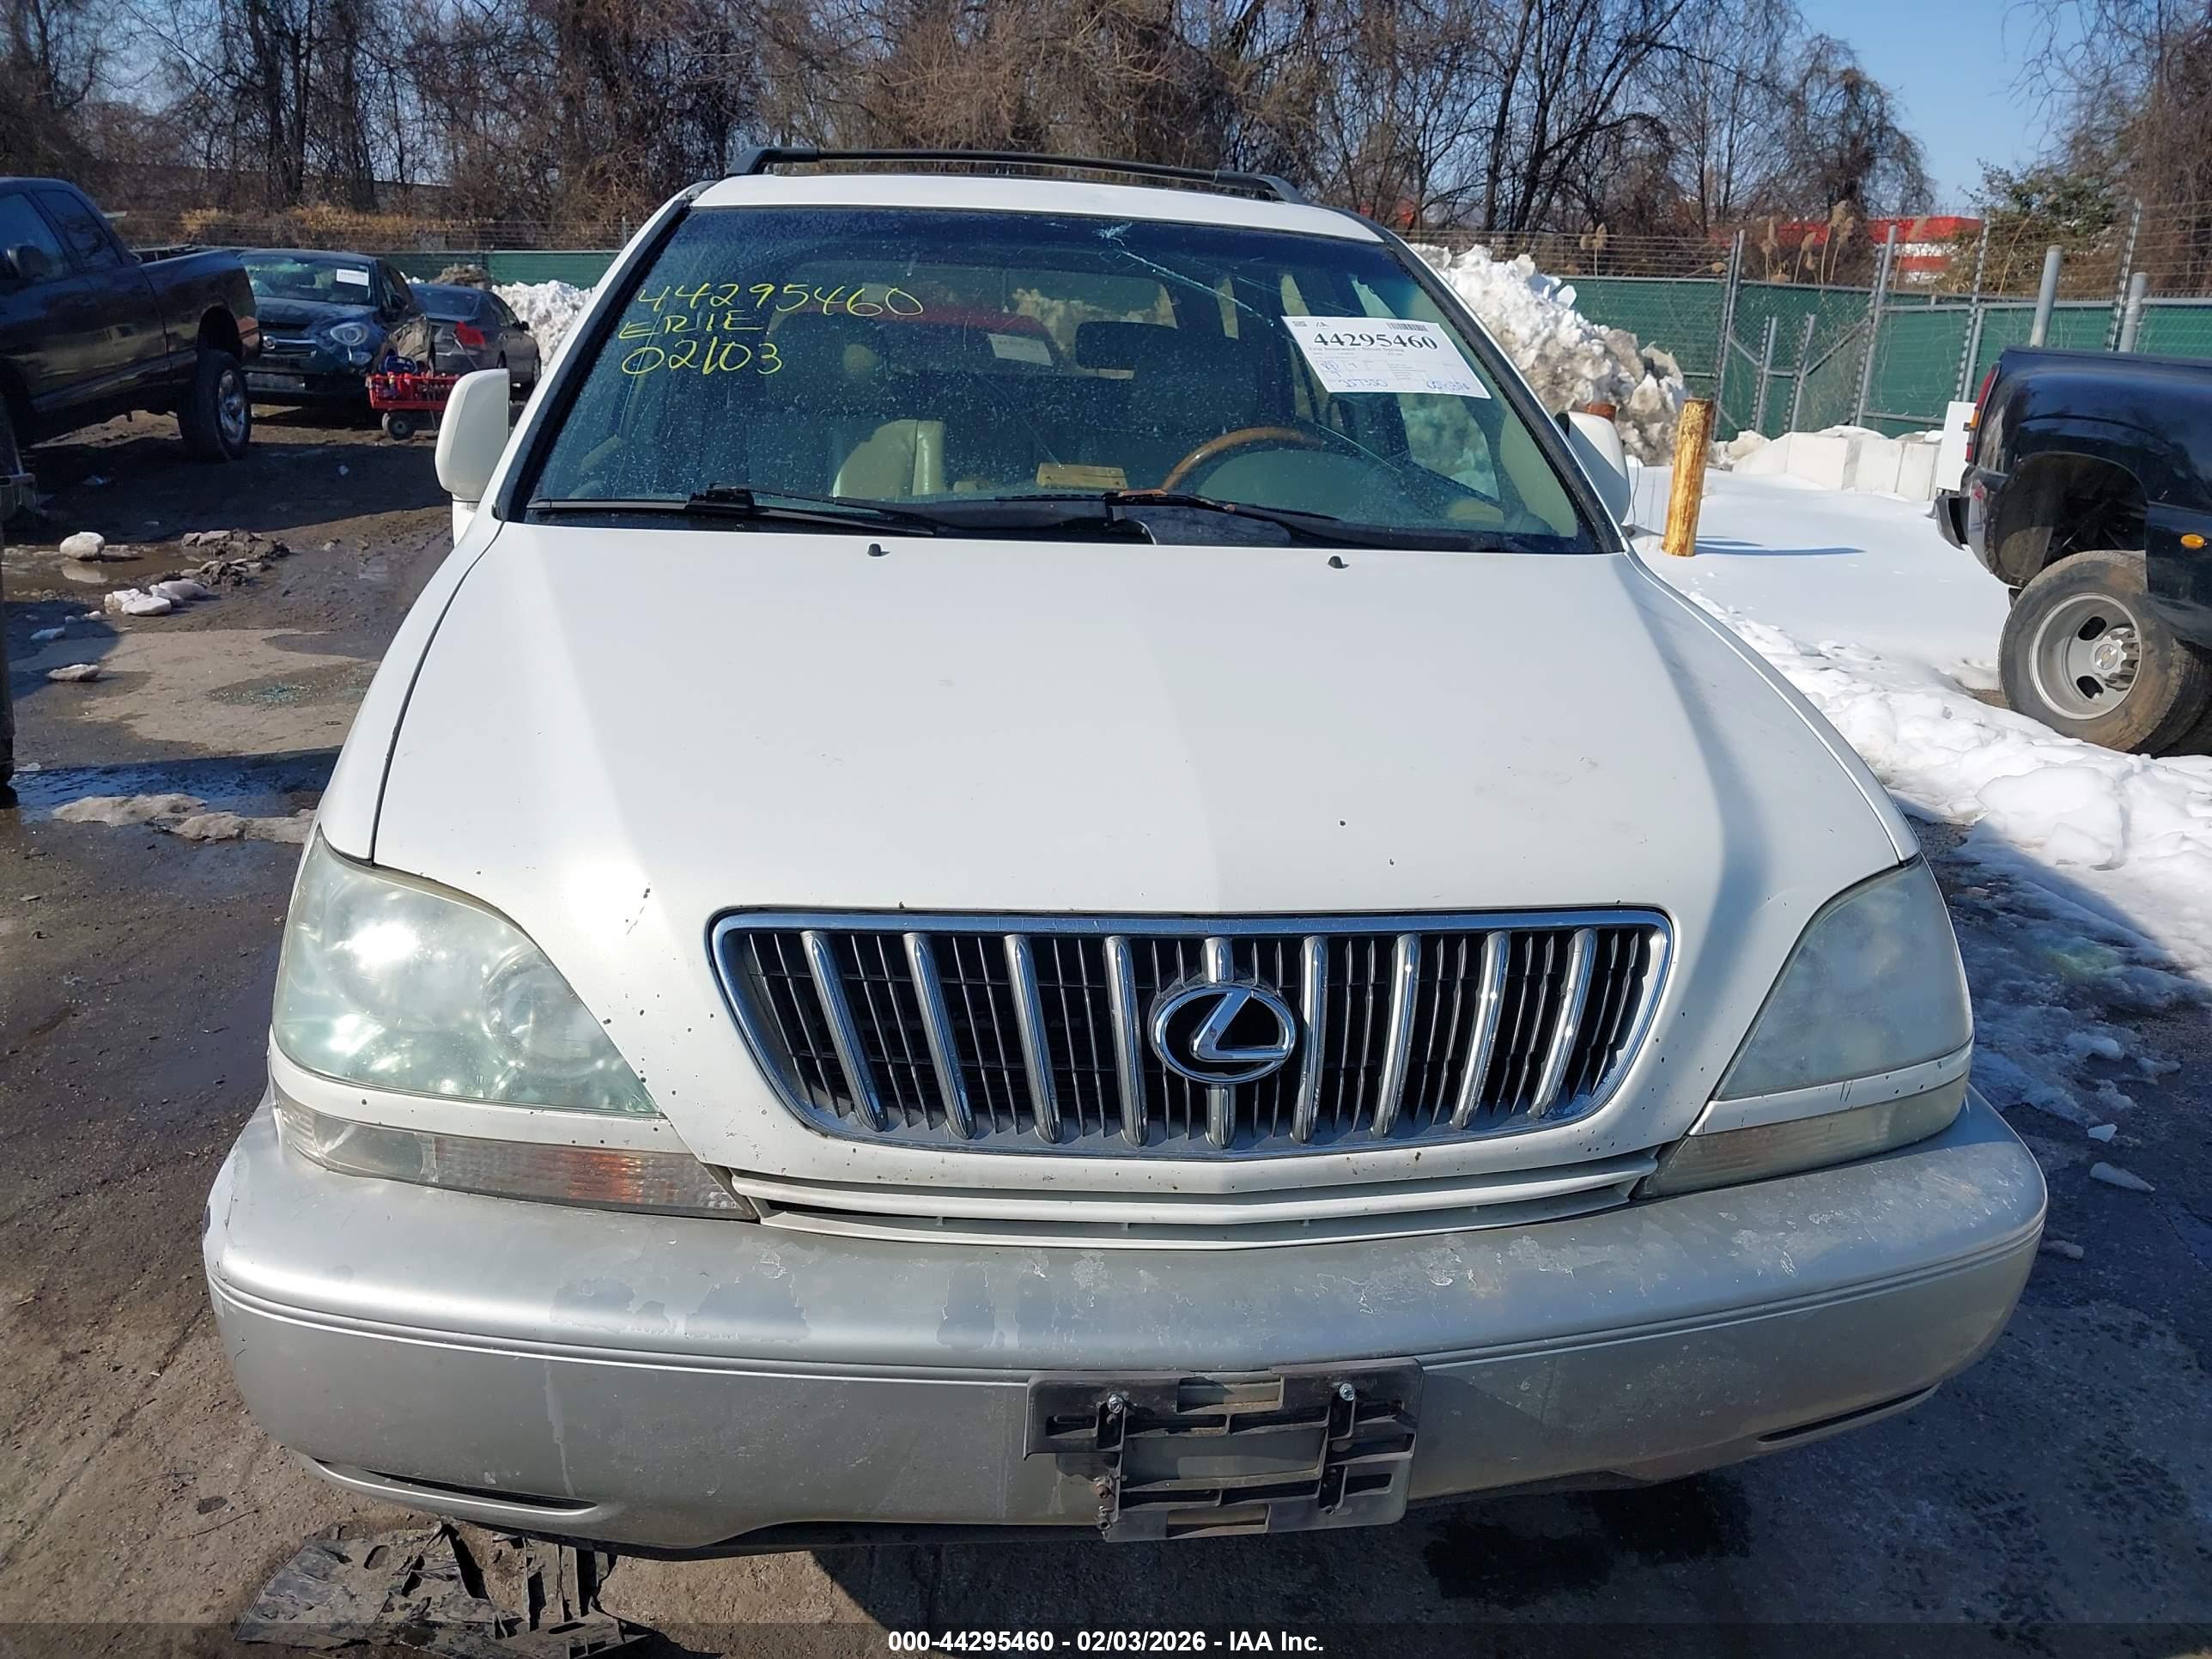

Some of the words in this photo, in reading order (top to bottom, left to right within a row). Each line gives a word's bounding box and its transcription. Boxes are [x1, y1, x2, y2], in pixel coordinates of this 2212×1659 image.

[638, 283, 924, 317] 44295460
[618, 310, 763, 339] ERIE
[1314, 332, 1438, 350] 44295460
